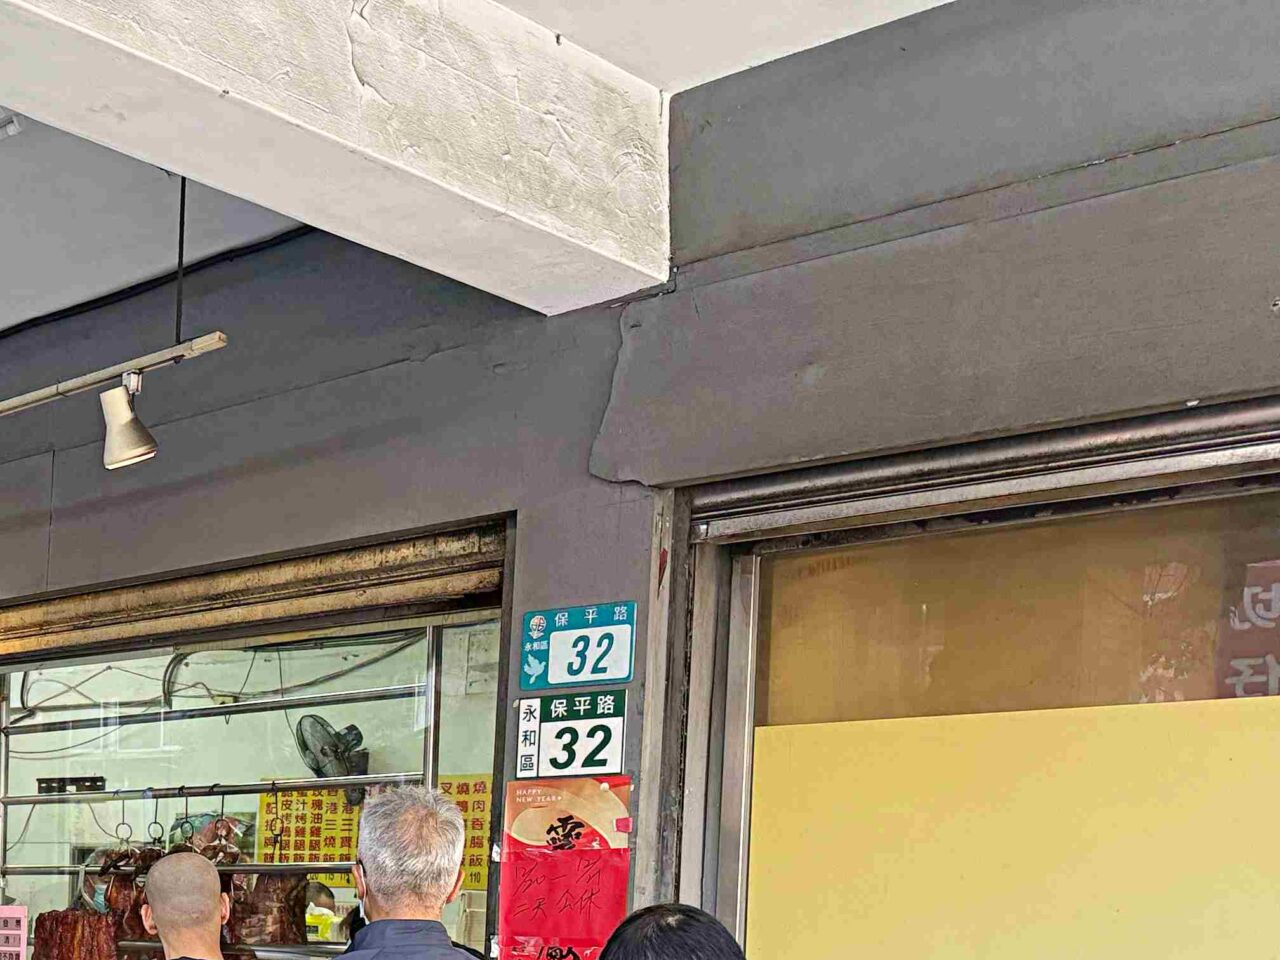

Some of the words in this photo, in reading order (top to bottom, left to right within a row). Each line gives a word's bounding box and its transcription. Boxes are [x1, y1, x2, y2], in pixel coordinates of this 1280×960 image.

[554, 606, 628, 627] 保平路
[524, 639, 549, 652] 永和區
[567, 632, 615, 677] 32
[550, 694, 616, 718] 保平路
[520, 704, 537, 772] 永和區
[549, 723, 613, 771] 32
[515, 788, 543, 796] HAPPY
[469, 781, 487, 867] 燒肉香腸飯
